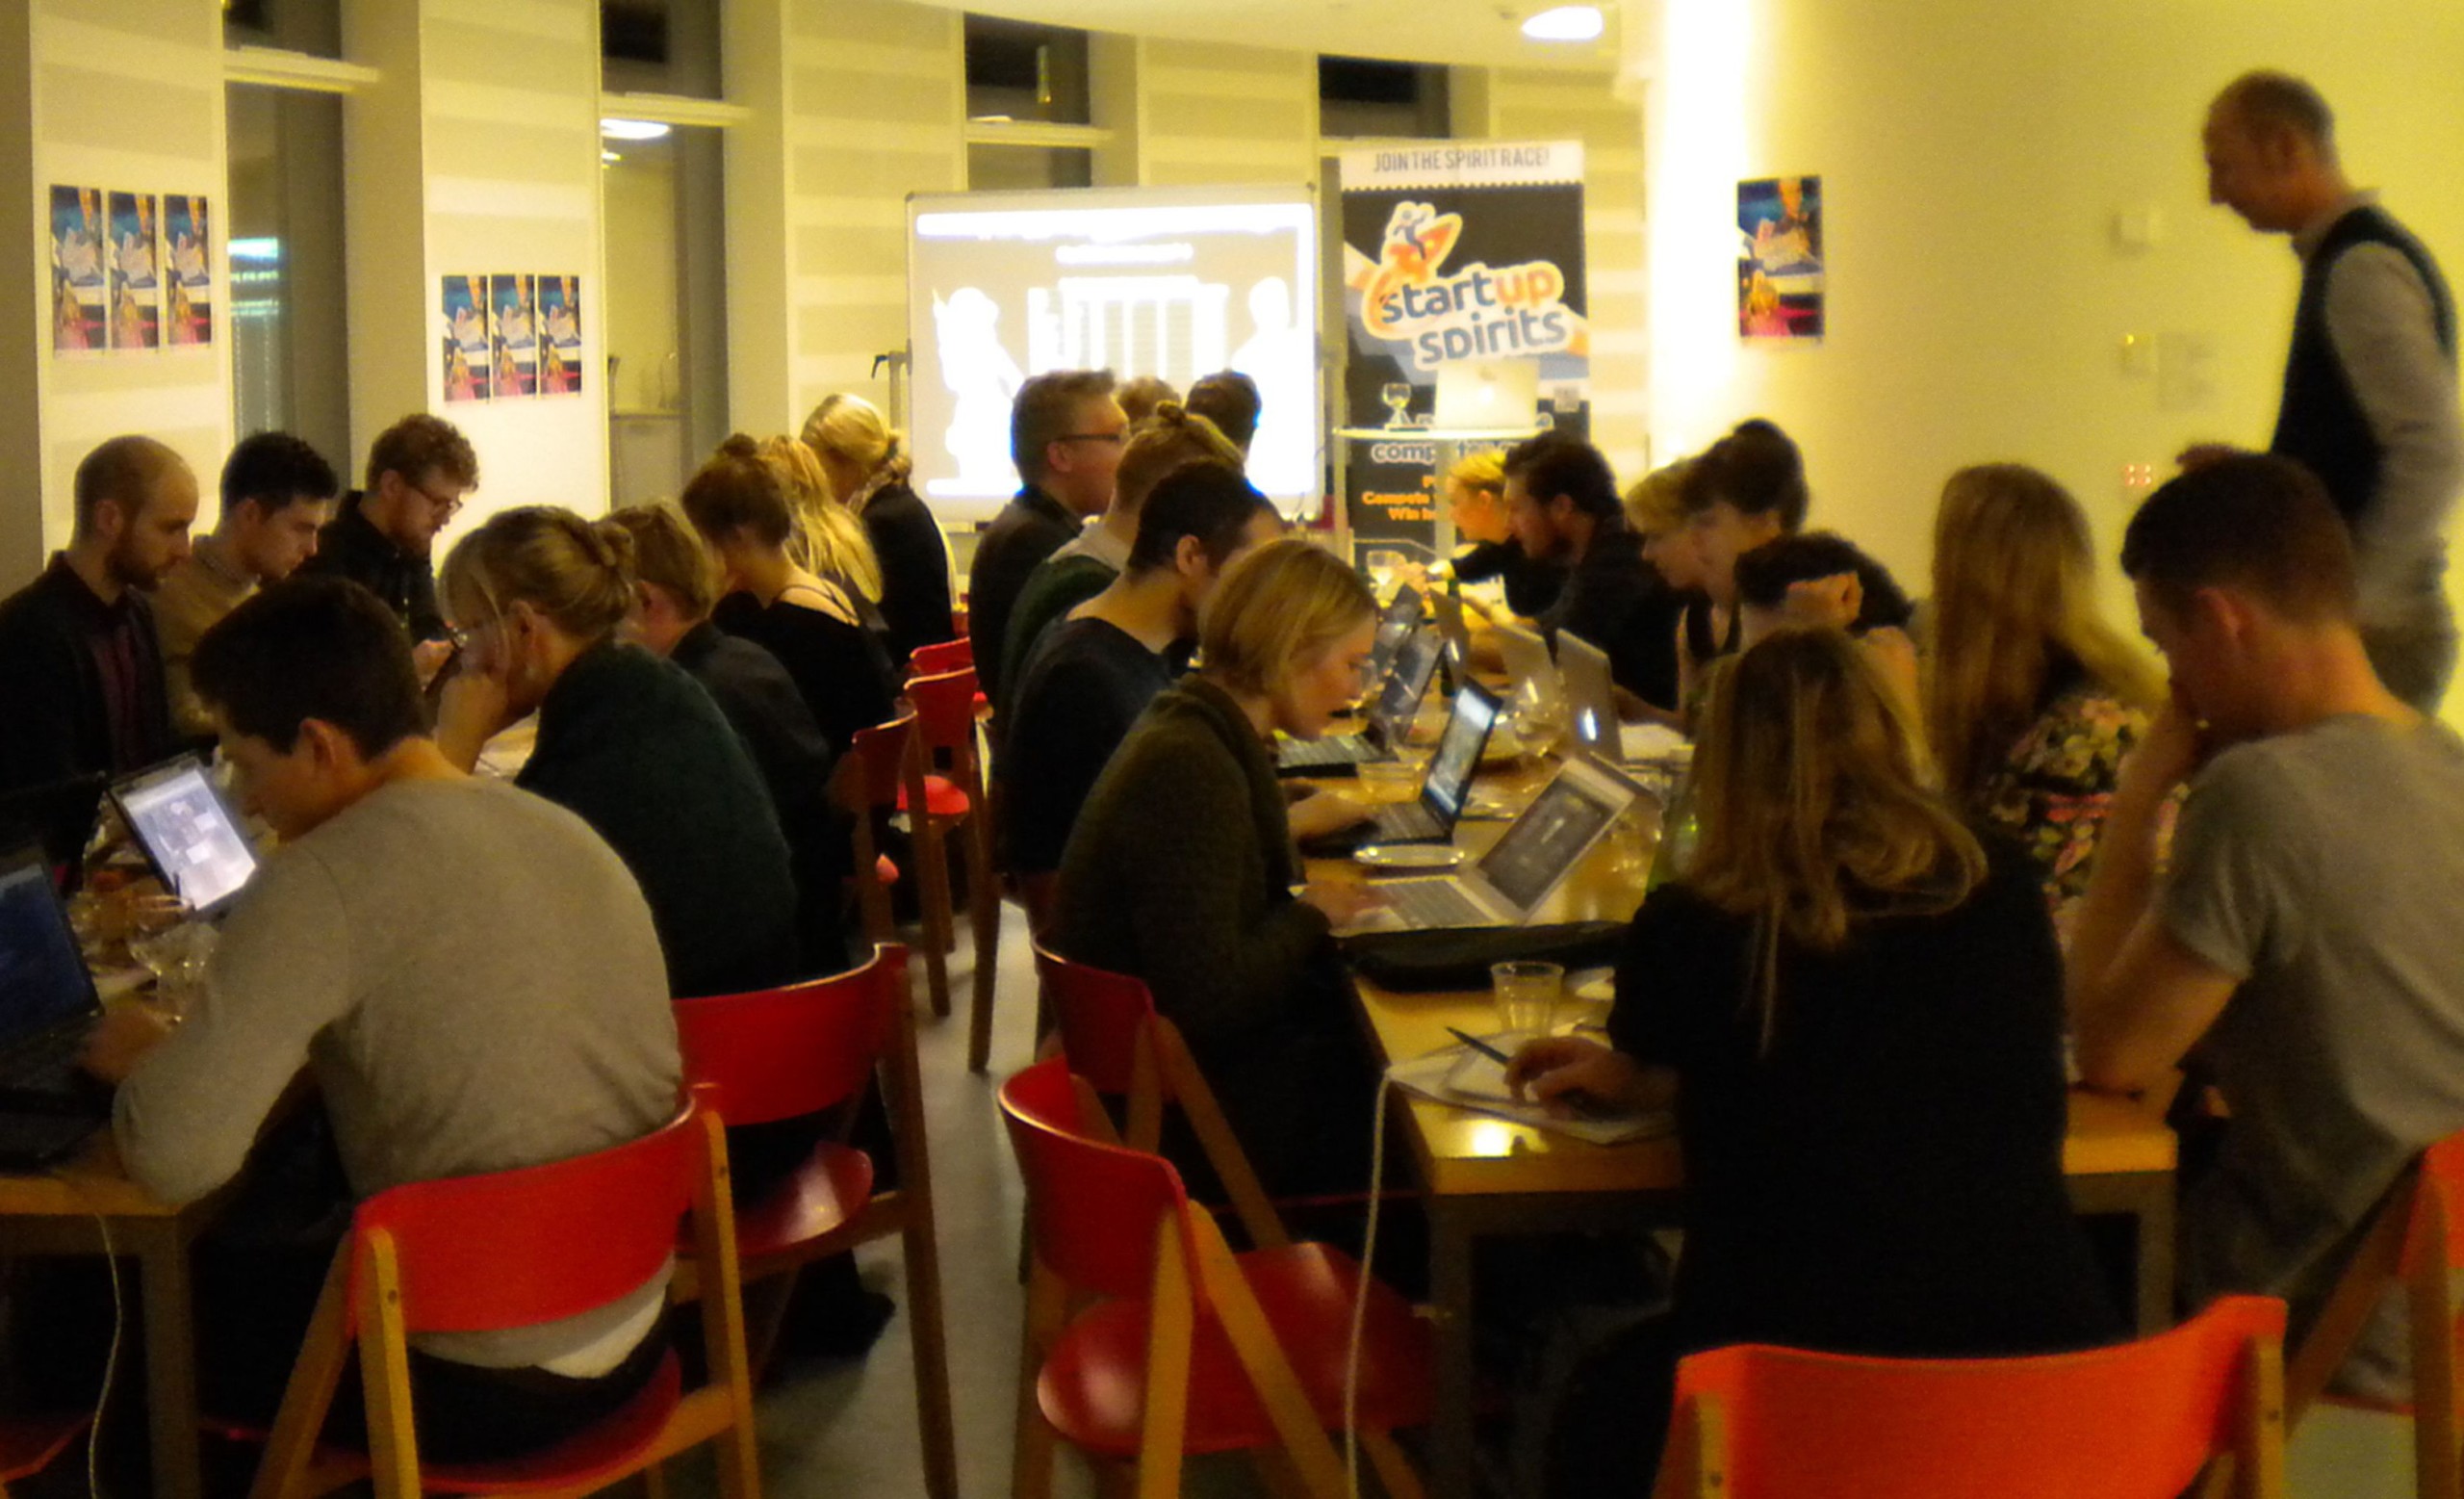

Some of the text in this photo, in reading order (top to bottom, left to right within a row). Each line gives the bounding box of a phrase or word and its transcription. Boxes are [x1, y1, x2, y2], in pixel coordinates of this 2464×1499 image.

[1374, 146, 1551, 172] JOIN THE SPIRIT RACE!
[1379, 270, 1555, 323] startup
[1419, 306, 1568, 365] spirits
